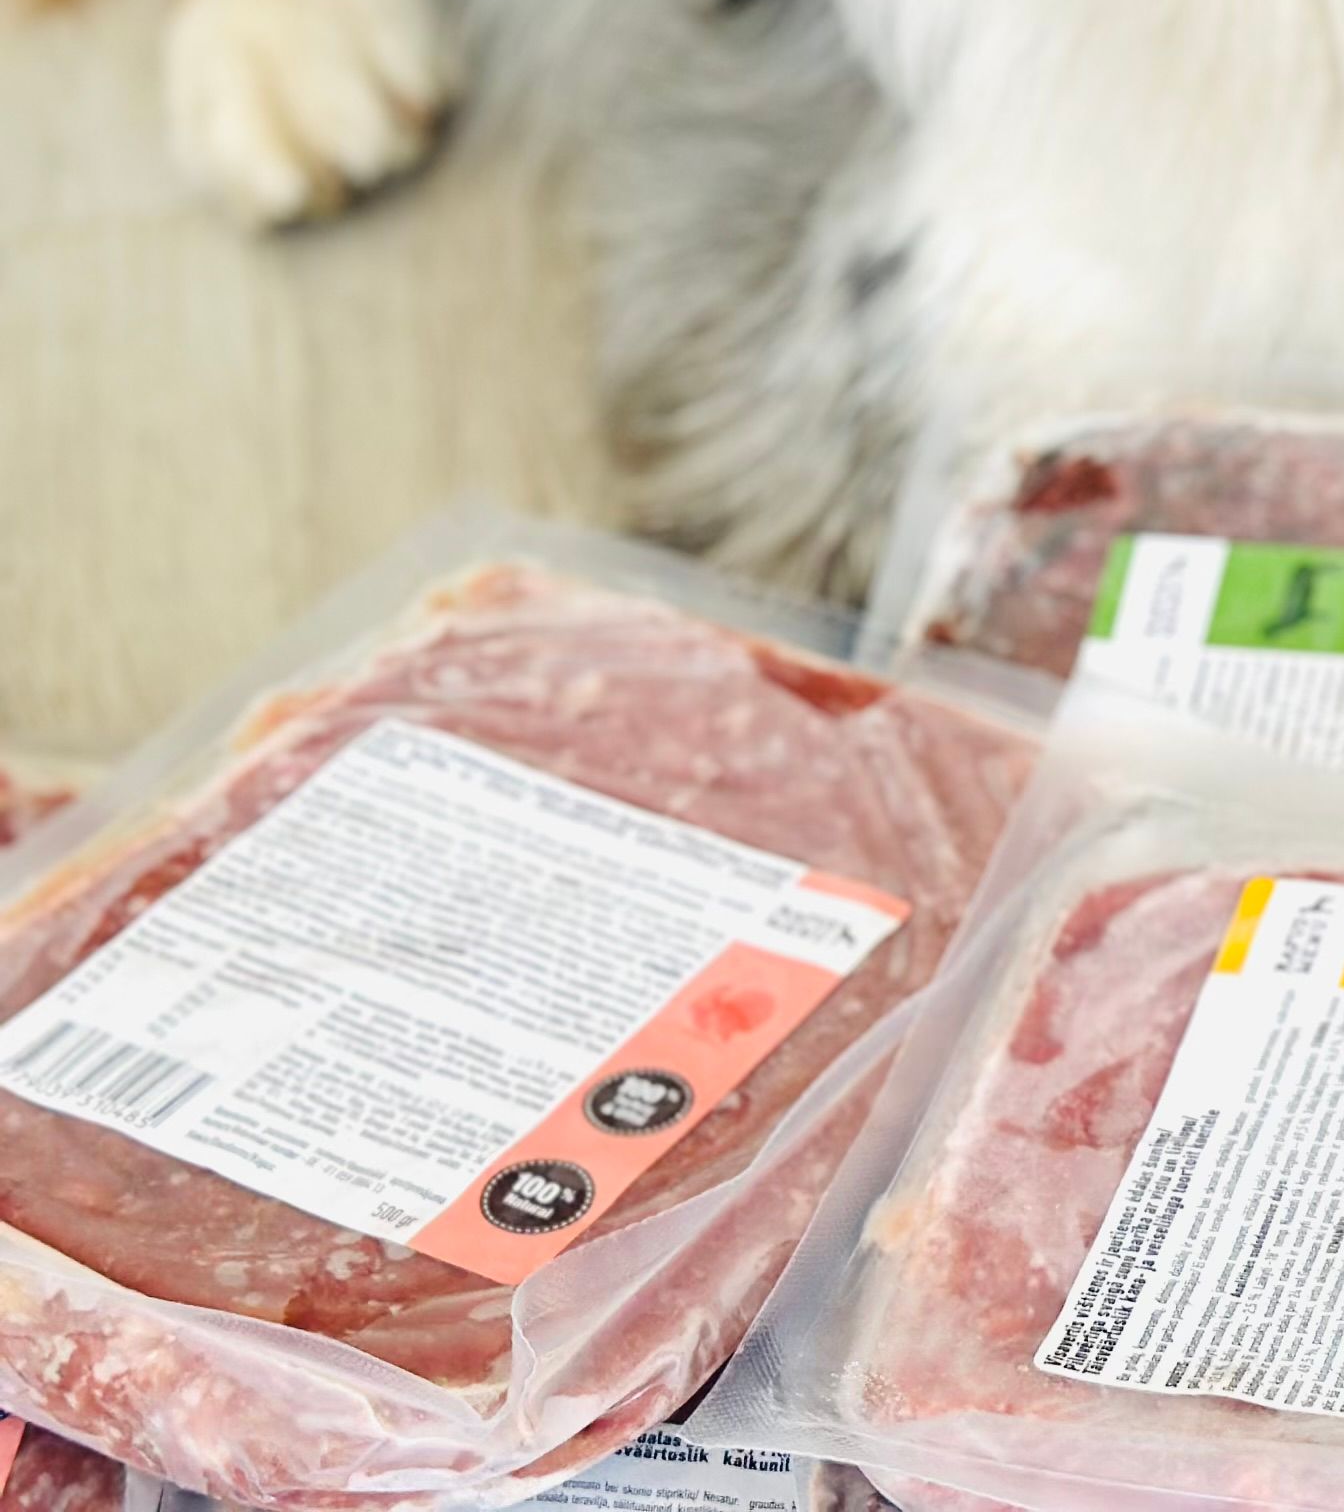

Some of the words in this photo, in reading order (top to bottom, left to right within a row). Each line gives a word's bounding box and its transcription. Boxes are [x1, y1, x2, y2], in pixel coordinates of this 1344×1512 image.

[1163, 1159, 1177, 1172] un
[511, 1170, 577, 1205] 100%
[1126, 1171, 1153, 1202] ėdalas
[1150, 1175, 1171, 1200] vistu
[370, 1201, 398, 1223] 500
[502, 1192, 555, 1221] Natural
[1144, 1202, 1158, 1214] ar
[1082, 1304, 1132, 1374] Täisväärtuslik
[1120, 1274, 1146, 1302] kana-
[1134, 1260, 1156, 1271] ja
[1146, 1196, 1183, 1256] veiselihaga
[1172, 1151, 1200, 1193] toortoit
[1188, 1110, 1220, 1149] koertele
[1101, 1206, 1136, 1258] jautienos
[1122, 1217, 1152, 1252] barība
[1095, 1258, 1114, 1268] ir
[1074, 1270, 1108, 1318] vištienos
[1098, 1282, 1124, 1317] svaigā
[1044, 1321, 1084, 1367] Visavertis
[633, 1431, 682, 1447] dalas
[614, 1444, 709, 1463] sväärtuslik
[723, 1449, 791, 1472] kalkunil
